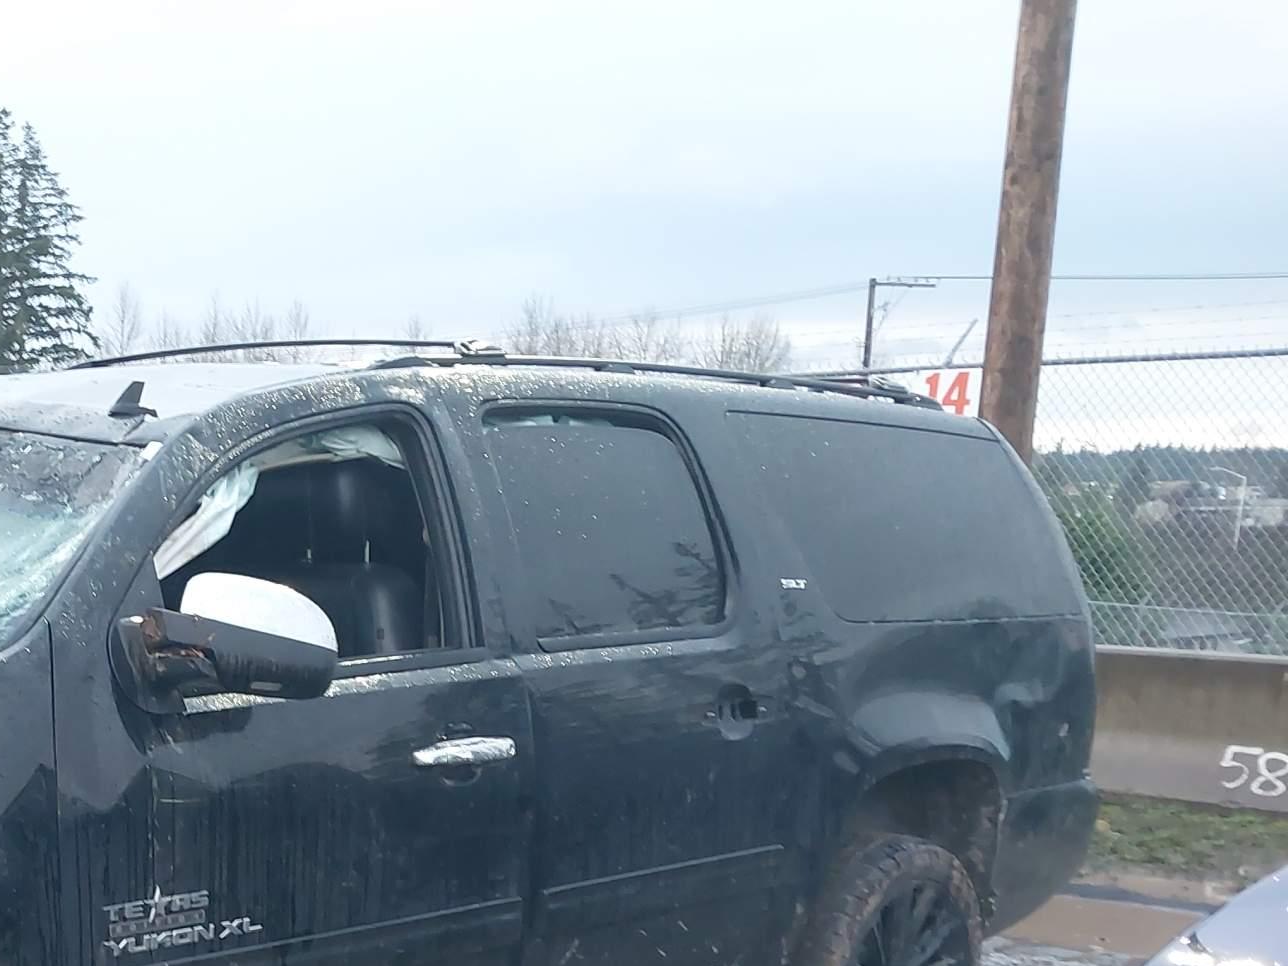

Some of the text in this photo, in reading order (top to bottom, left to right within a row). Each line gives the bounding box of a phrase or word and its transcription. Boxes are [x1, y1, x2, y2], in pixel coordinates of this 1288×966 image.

[925, 372, 970, 415] 14
[780, 578, 808, 590] SLT
[1219, 744, 1288, 797] 58
[102, 886, 210, 923] TEXAS
[103, 922, 215, 957] YUKON
[218, 916, 263, 940] XL
